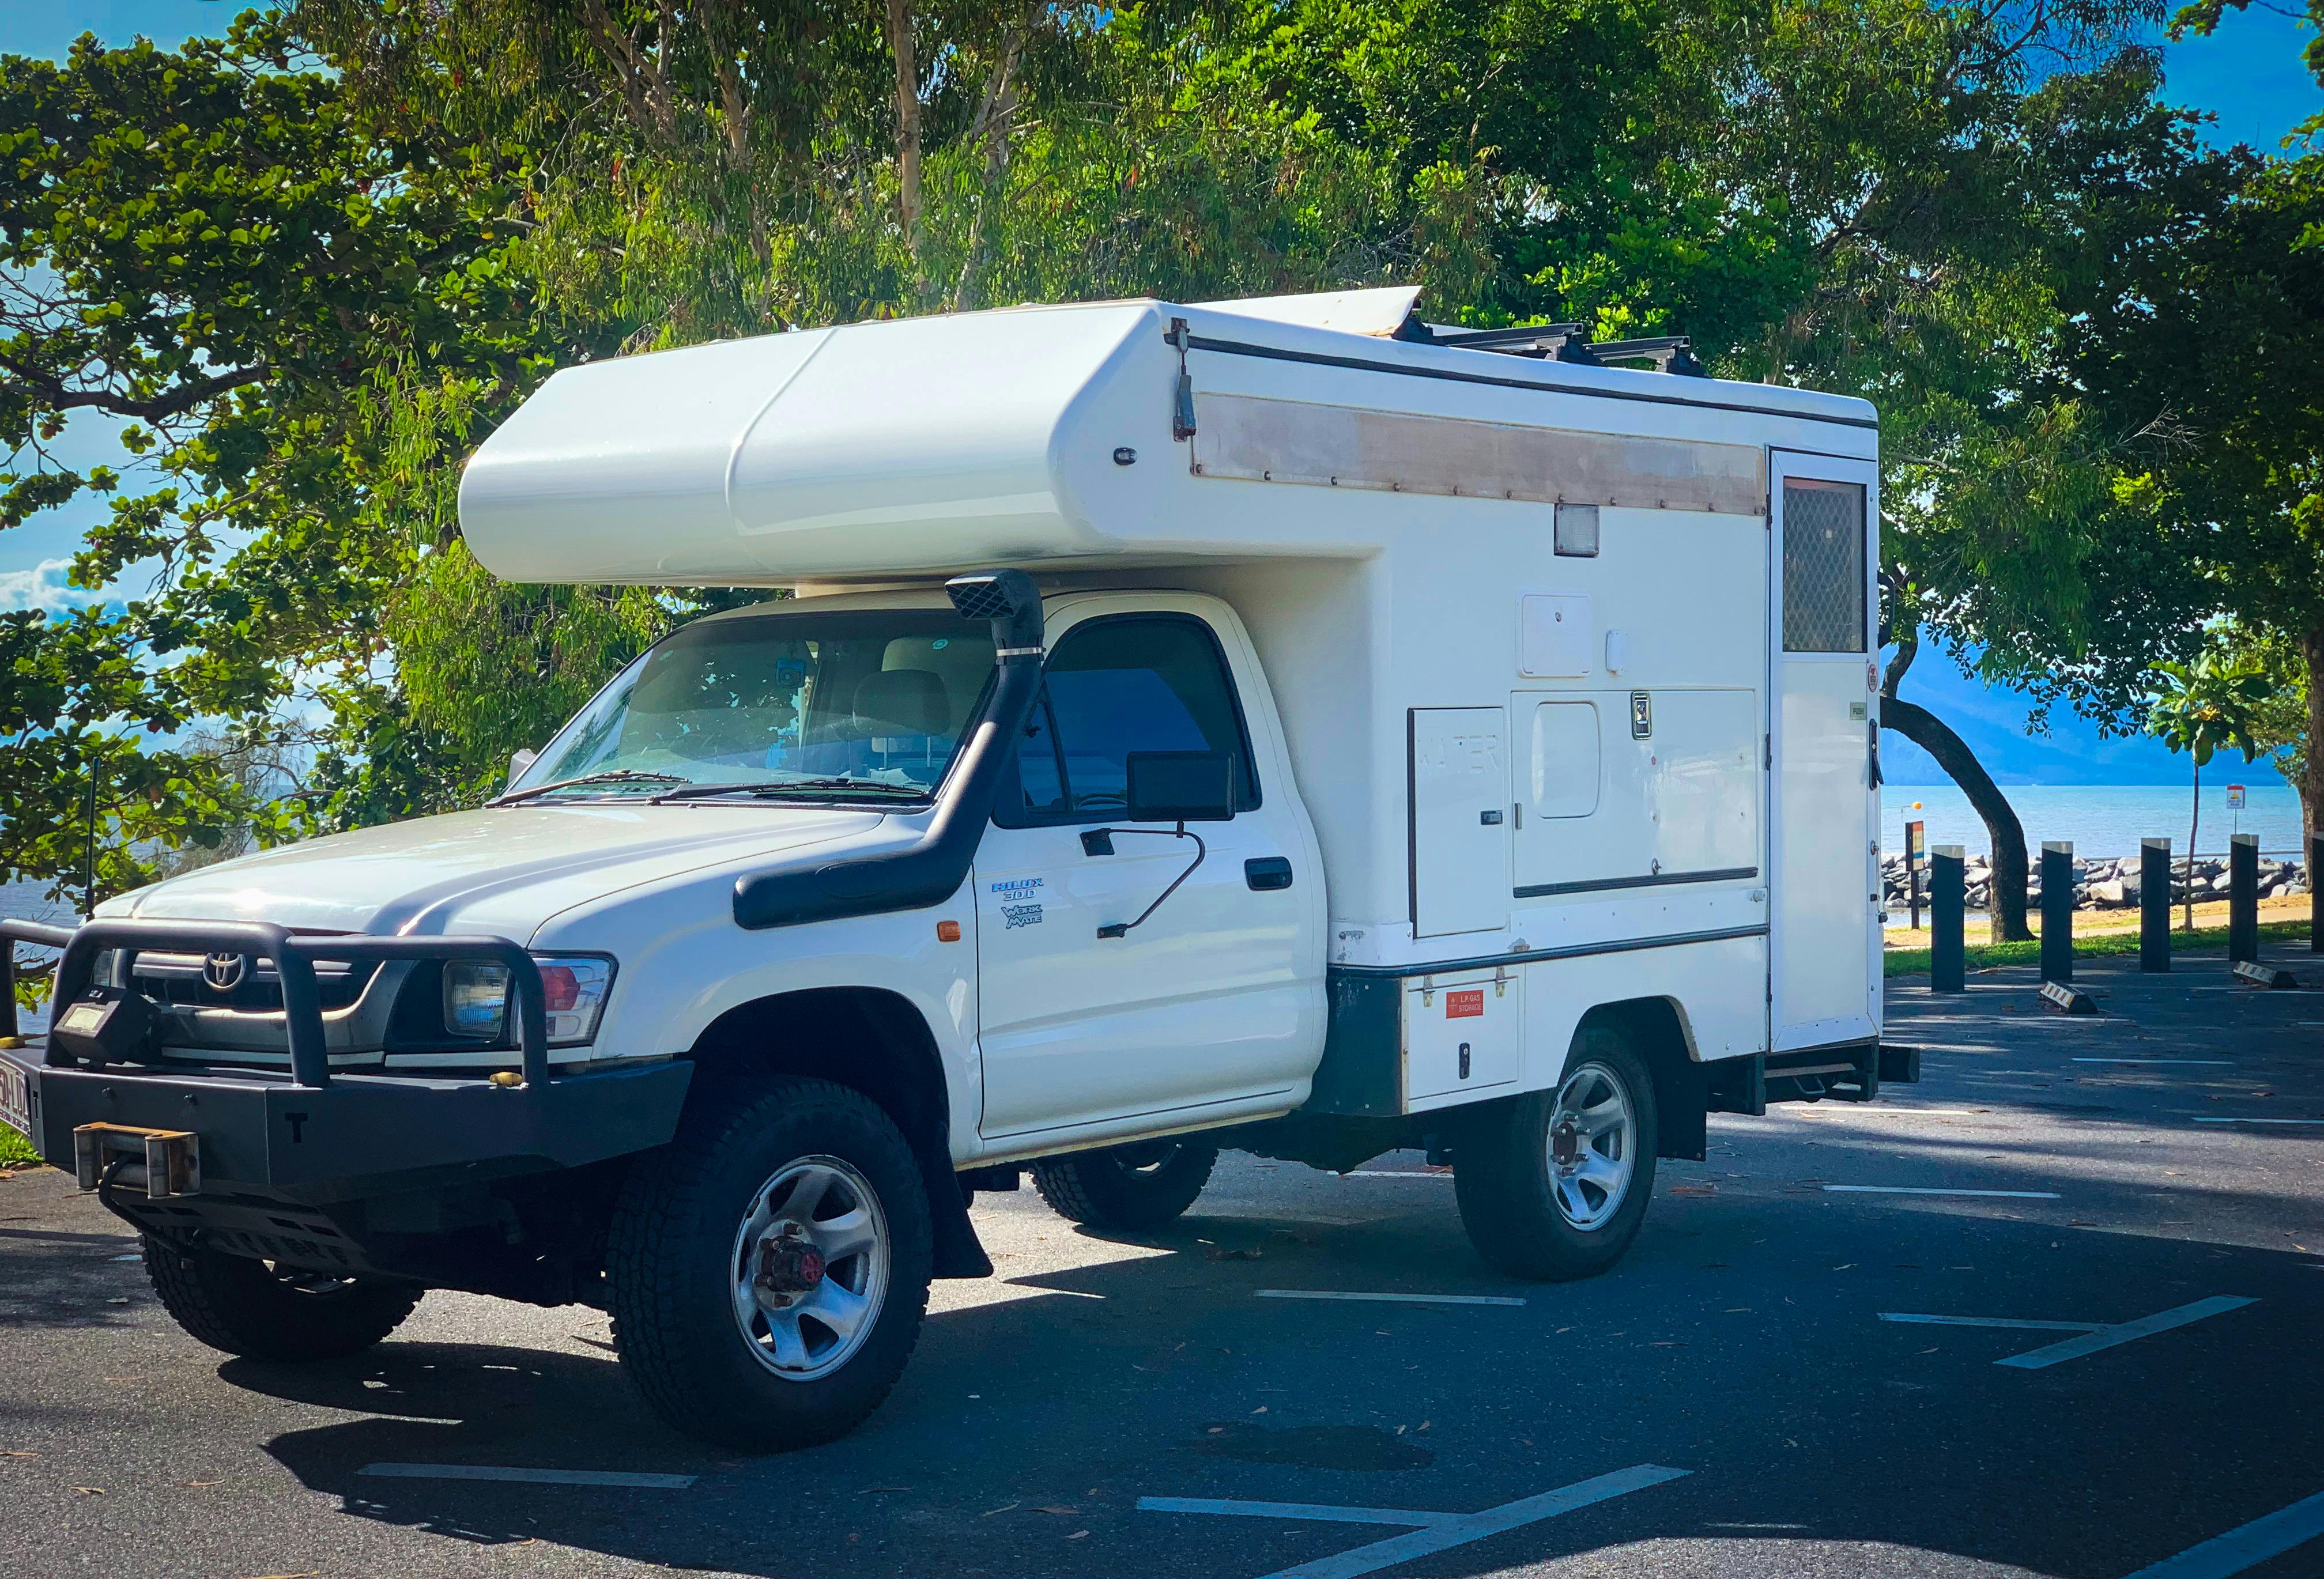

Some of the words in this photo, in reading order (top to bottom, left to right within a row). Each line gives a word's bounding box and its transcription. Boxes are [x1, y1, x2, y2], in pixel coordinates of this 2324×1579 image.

[991, 878, 1044, 893] HILUX
[1001, 904, 1043, 917] WORK
[1005, 916, 1042, 929] MATE
[1470, 994, 1480, 1002] GAS
[1458, 1003, 1481, 1013] STORAGE
[285, 1113, 308, 1143] T
